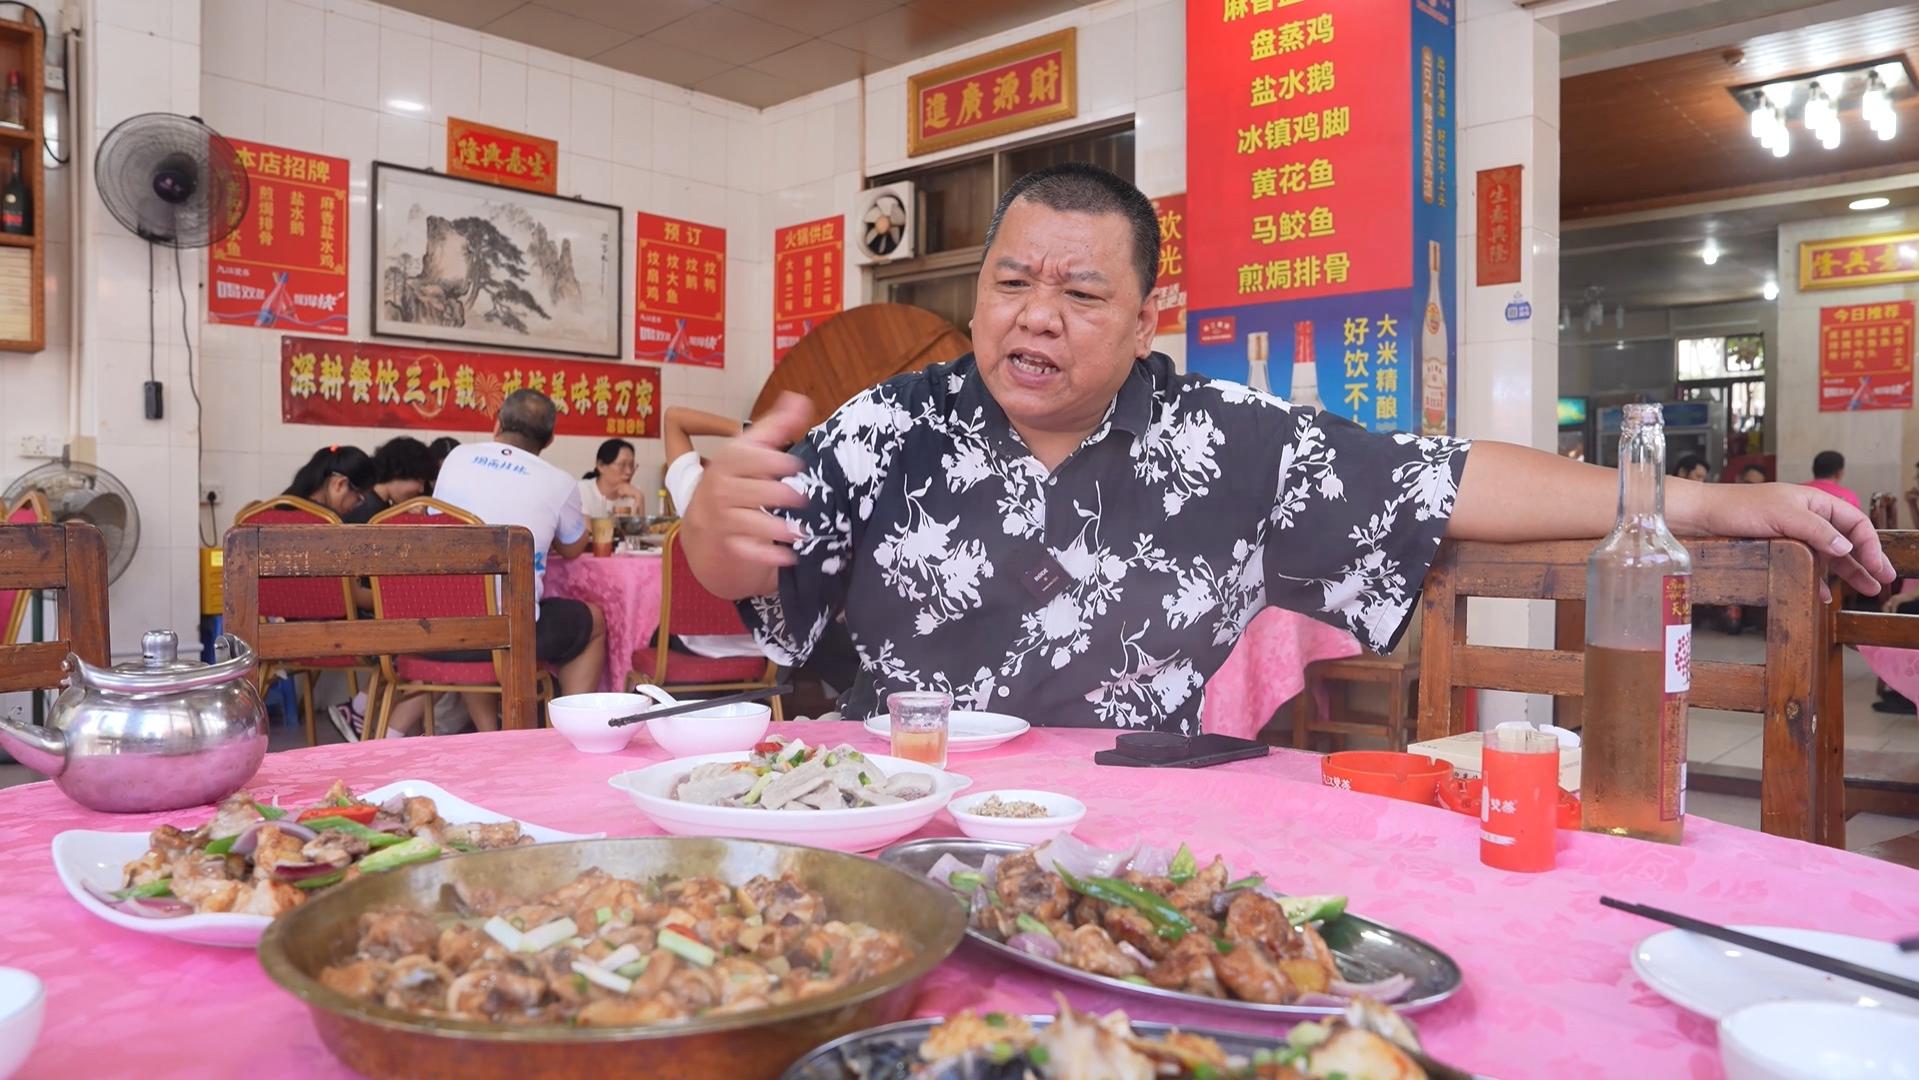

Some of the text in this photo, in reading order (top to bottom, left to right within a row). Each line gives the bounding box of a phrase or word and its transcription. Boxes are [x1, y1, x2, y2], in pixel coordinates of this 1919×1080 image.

[1251, 13, 1335, 61] 盘蒸鸡
[1251, 60, 1335, 107] 盐水鹅
[1237, 106, 1350, 154] 冰镇鸡脚
[235, 147, 331, 183] 本店招牌
[1251, 158, 1335, 199] 黄花鱼
[785, 223, 834, 249] 火锅供应
[1251, 206, 1335, 244] 马鲛鱼
[1237, 252, 1350, 295] 煎焗排骨
